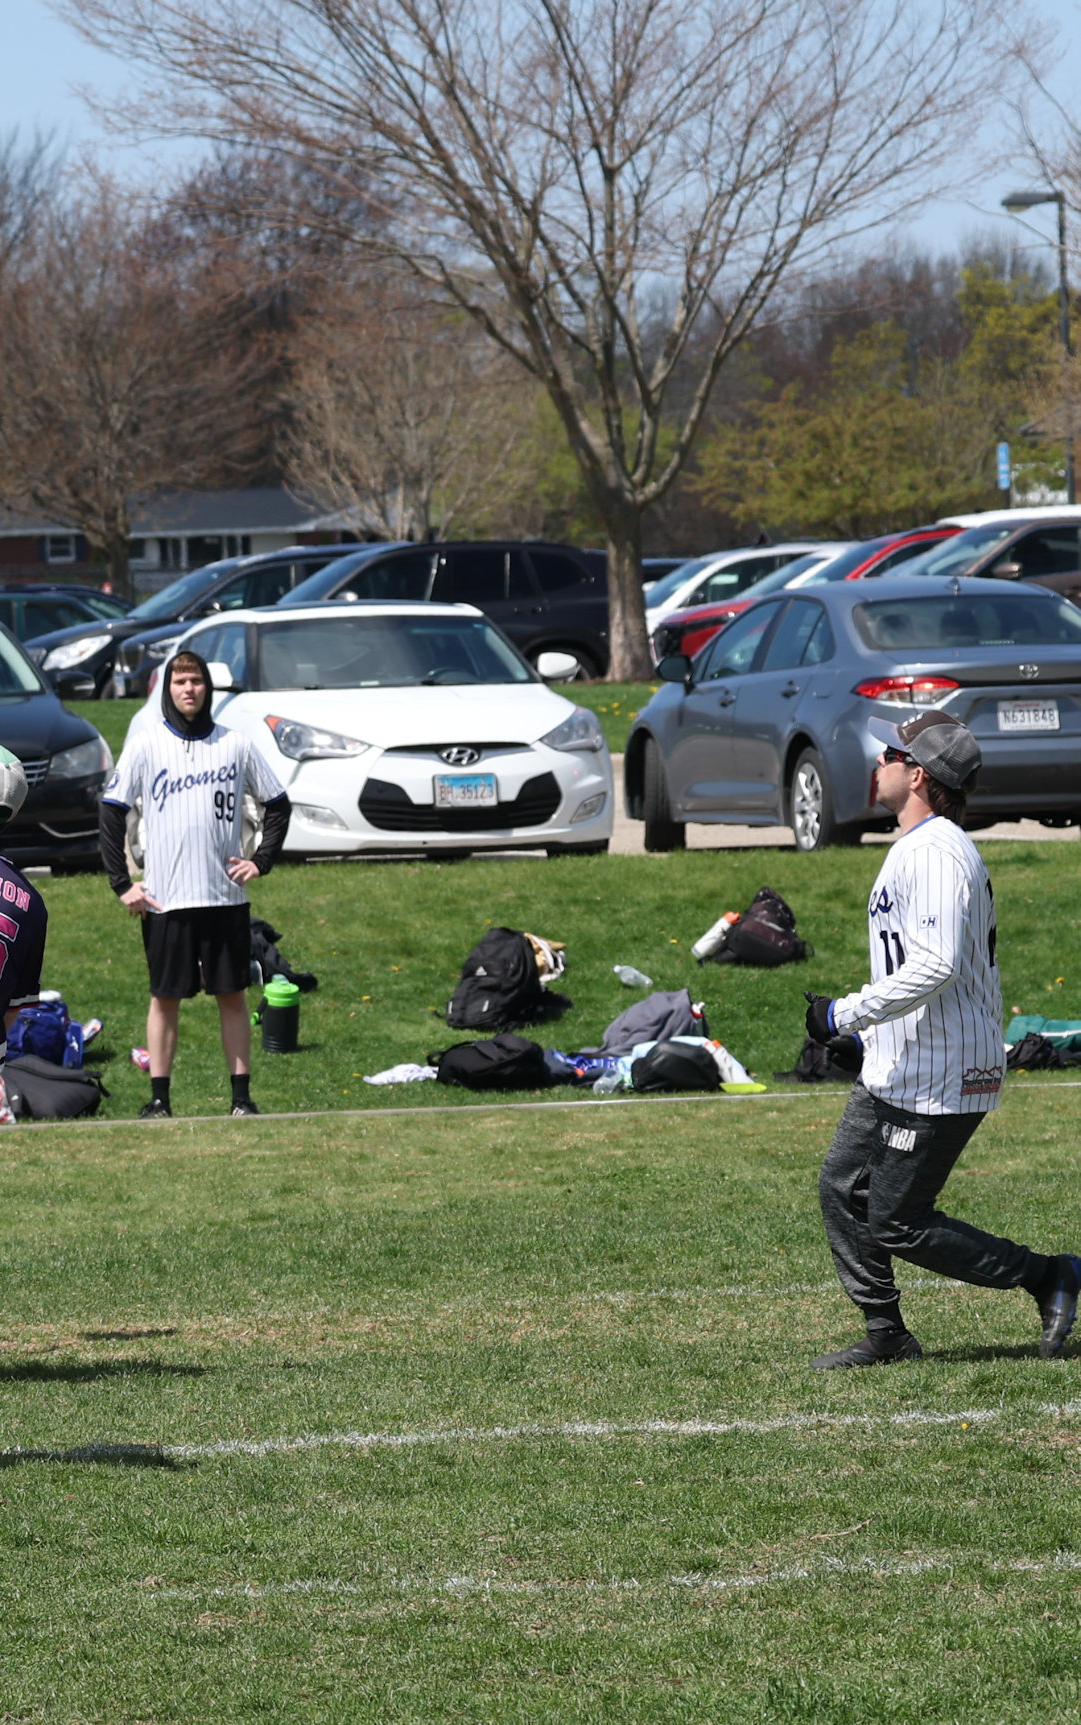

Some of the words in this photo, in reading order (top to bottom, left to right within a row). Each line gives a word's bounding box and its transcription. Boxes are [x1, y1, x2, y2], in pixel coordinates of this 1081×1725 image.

[152, 762, 238, 812] Gnomes
[879, 930, 905, 976] 11
[887, 1125, 917, 1152] NBA
